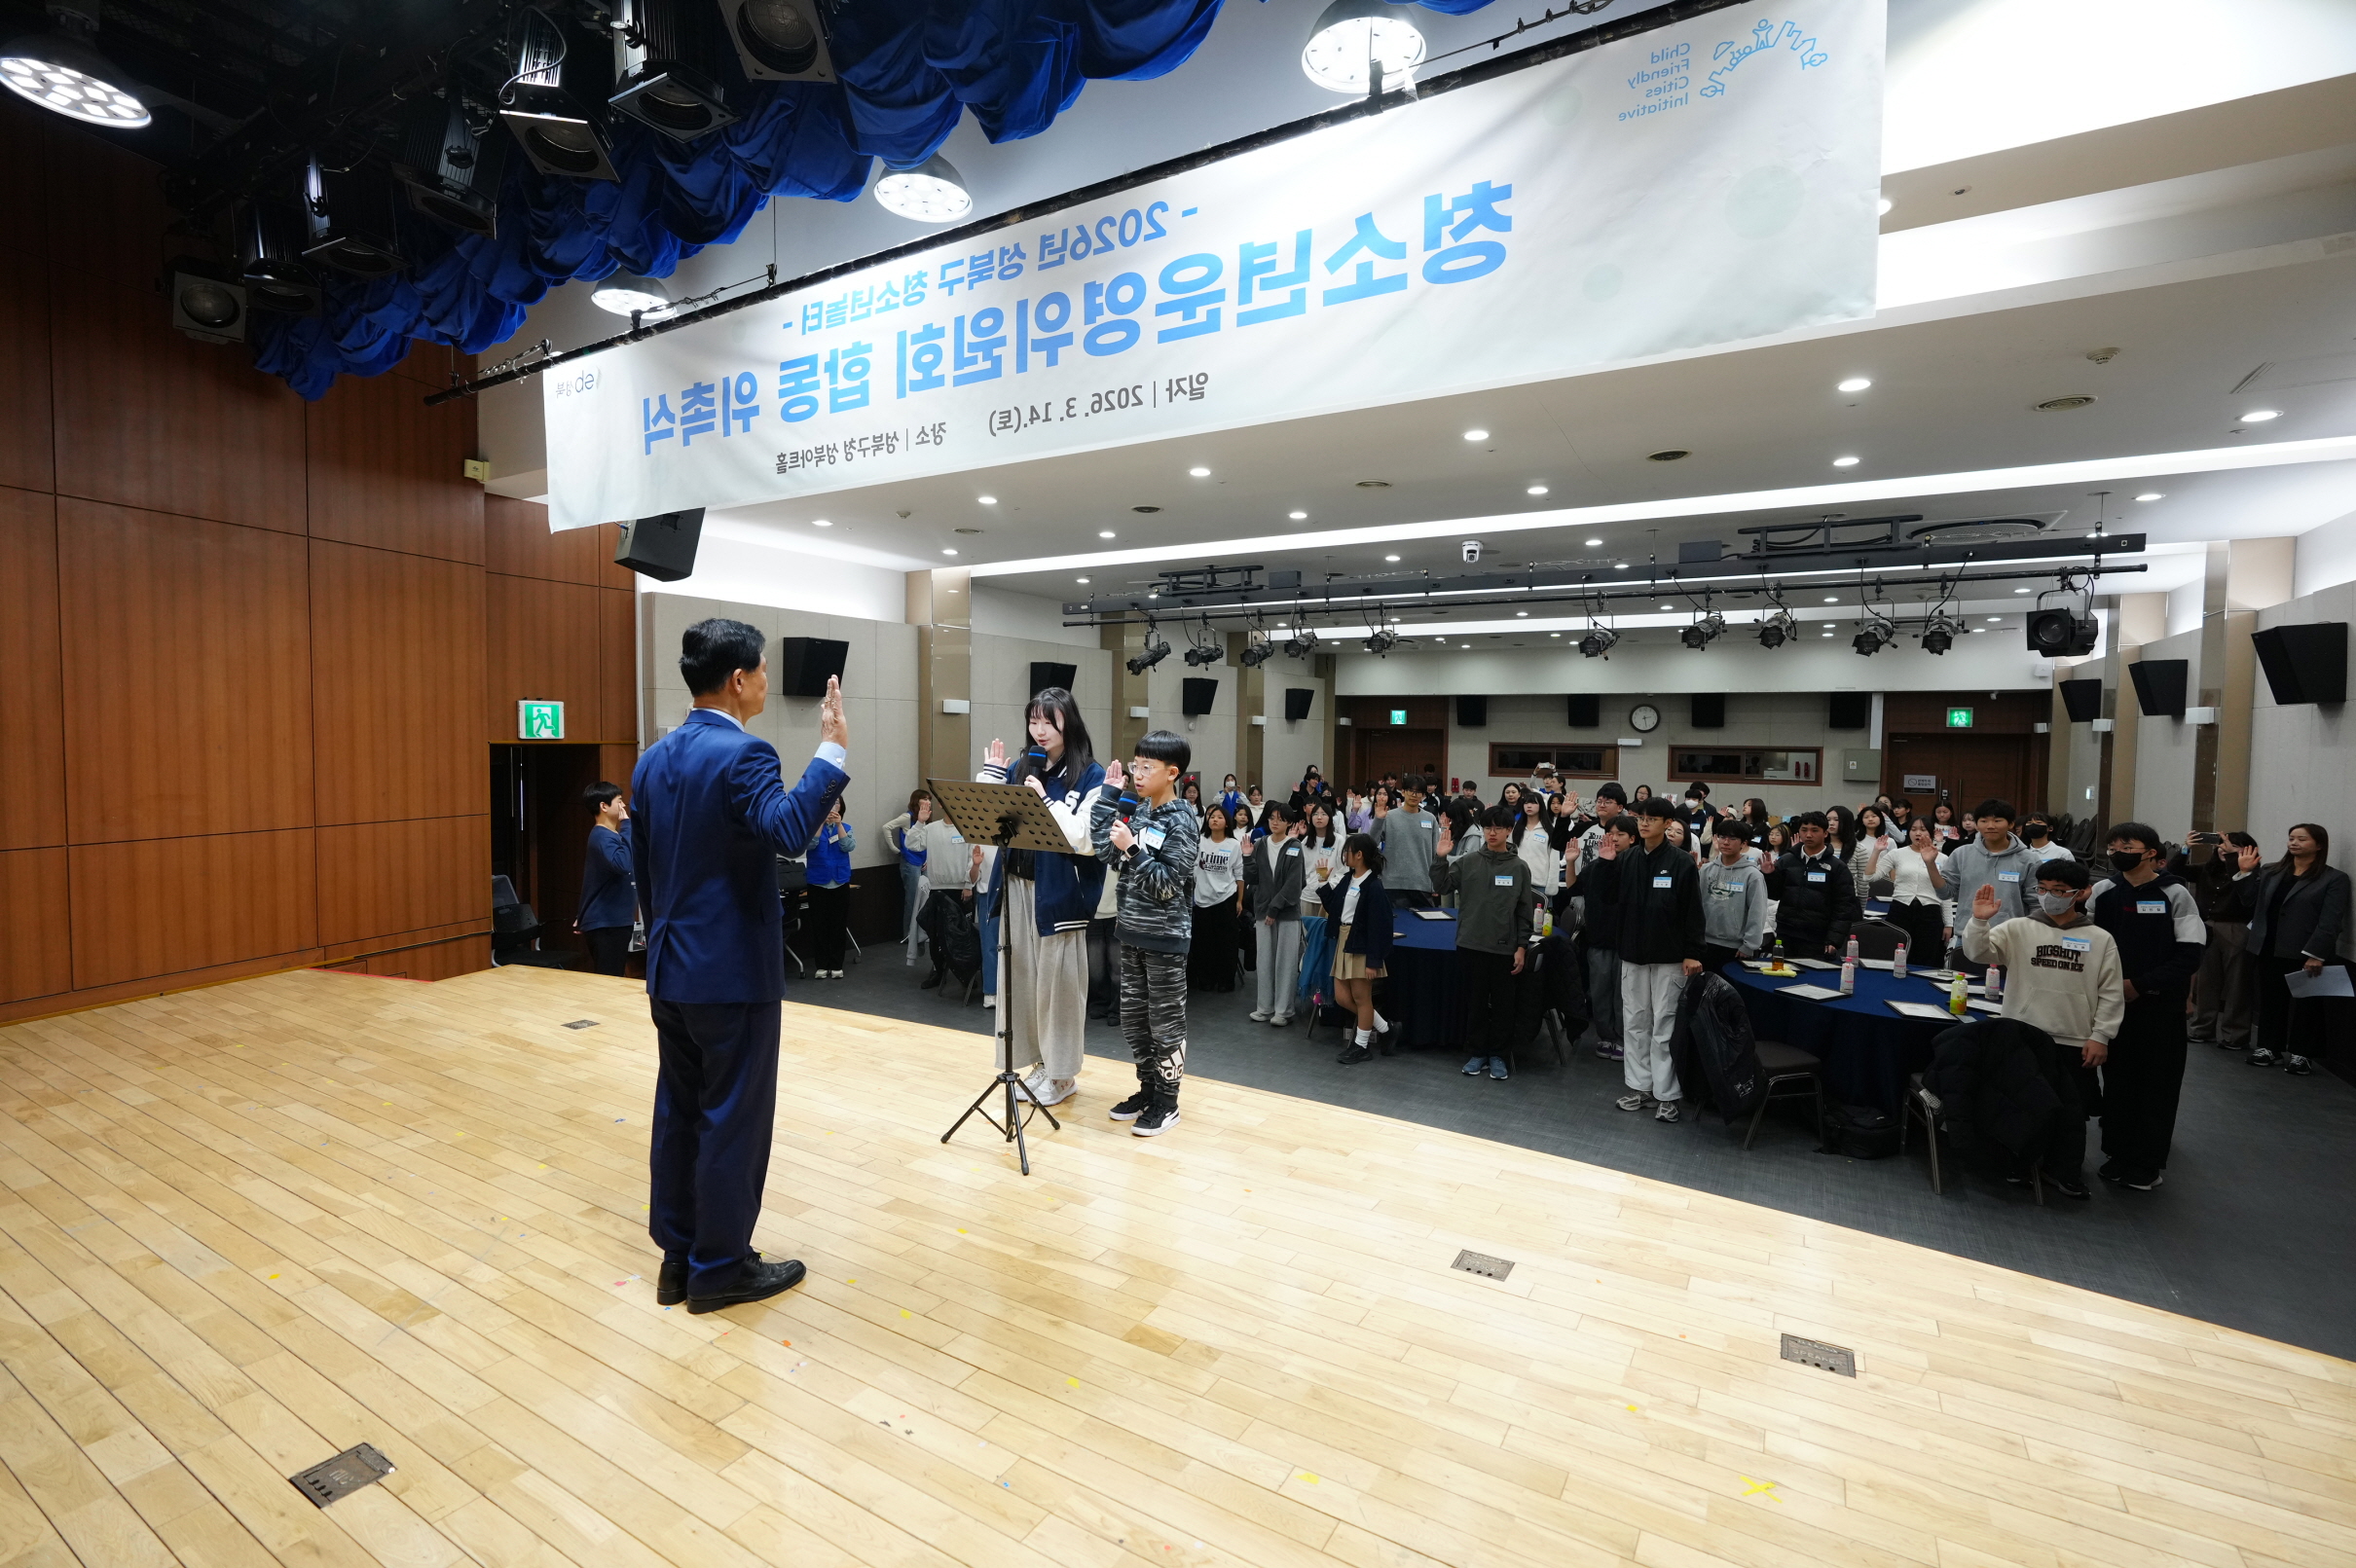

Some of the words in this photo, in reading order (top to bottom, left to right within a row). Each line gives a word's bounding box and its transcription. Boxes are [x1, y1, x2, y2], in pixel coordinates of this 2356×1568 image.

[2031, 957, 2058, 968] SPEED
[2057, 960, 2071, 971] ON
[2070, 962, 2084, 972] ICE
